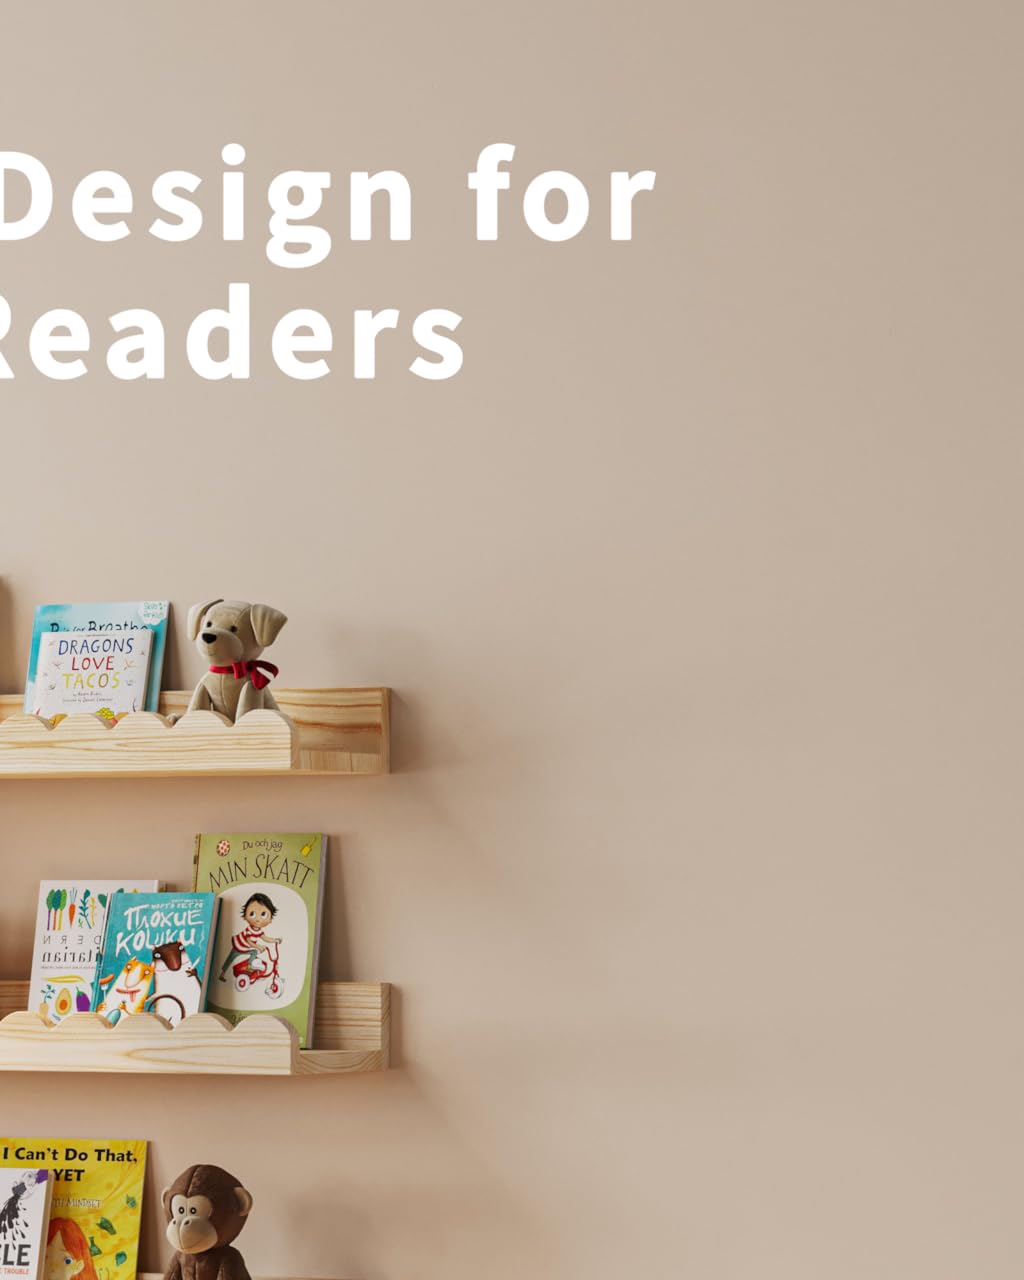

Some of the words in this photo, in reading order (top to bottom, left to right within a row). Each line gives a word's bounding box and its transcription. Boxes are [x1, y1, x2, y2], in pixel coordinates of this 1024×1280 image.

[58, 637, 135, 656] DRAGONS
[71, 655, 115, 671] LOVE
[62, 671, 120, 689] TACOS
[242, 840, 253, 850] Du
[254, 838, 268, 847] och
[269, 840, 283, 852] jag
[209, 857, 247, 893] MIN
[253, 853, 315, 889] SKATT
[3, 1146, 9, 1160] I
[14, 1147, 59, 1161] Can't
[64, 1148, 88, 1161] Do
[53, 1168, 85, 1181] YET
